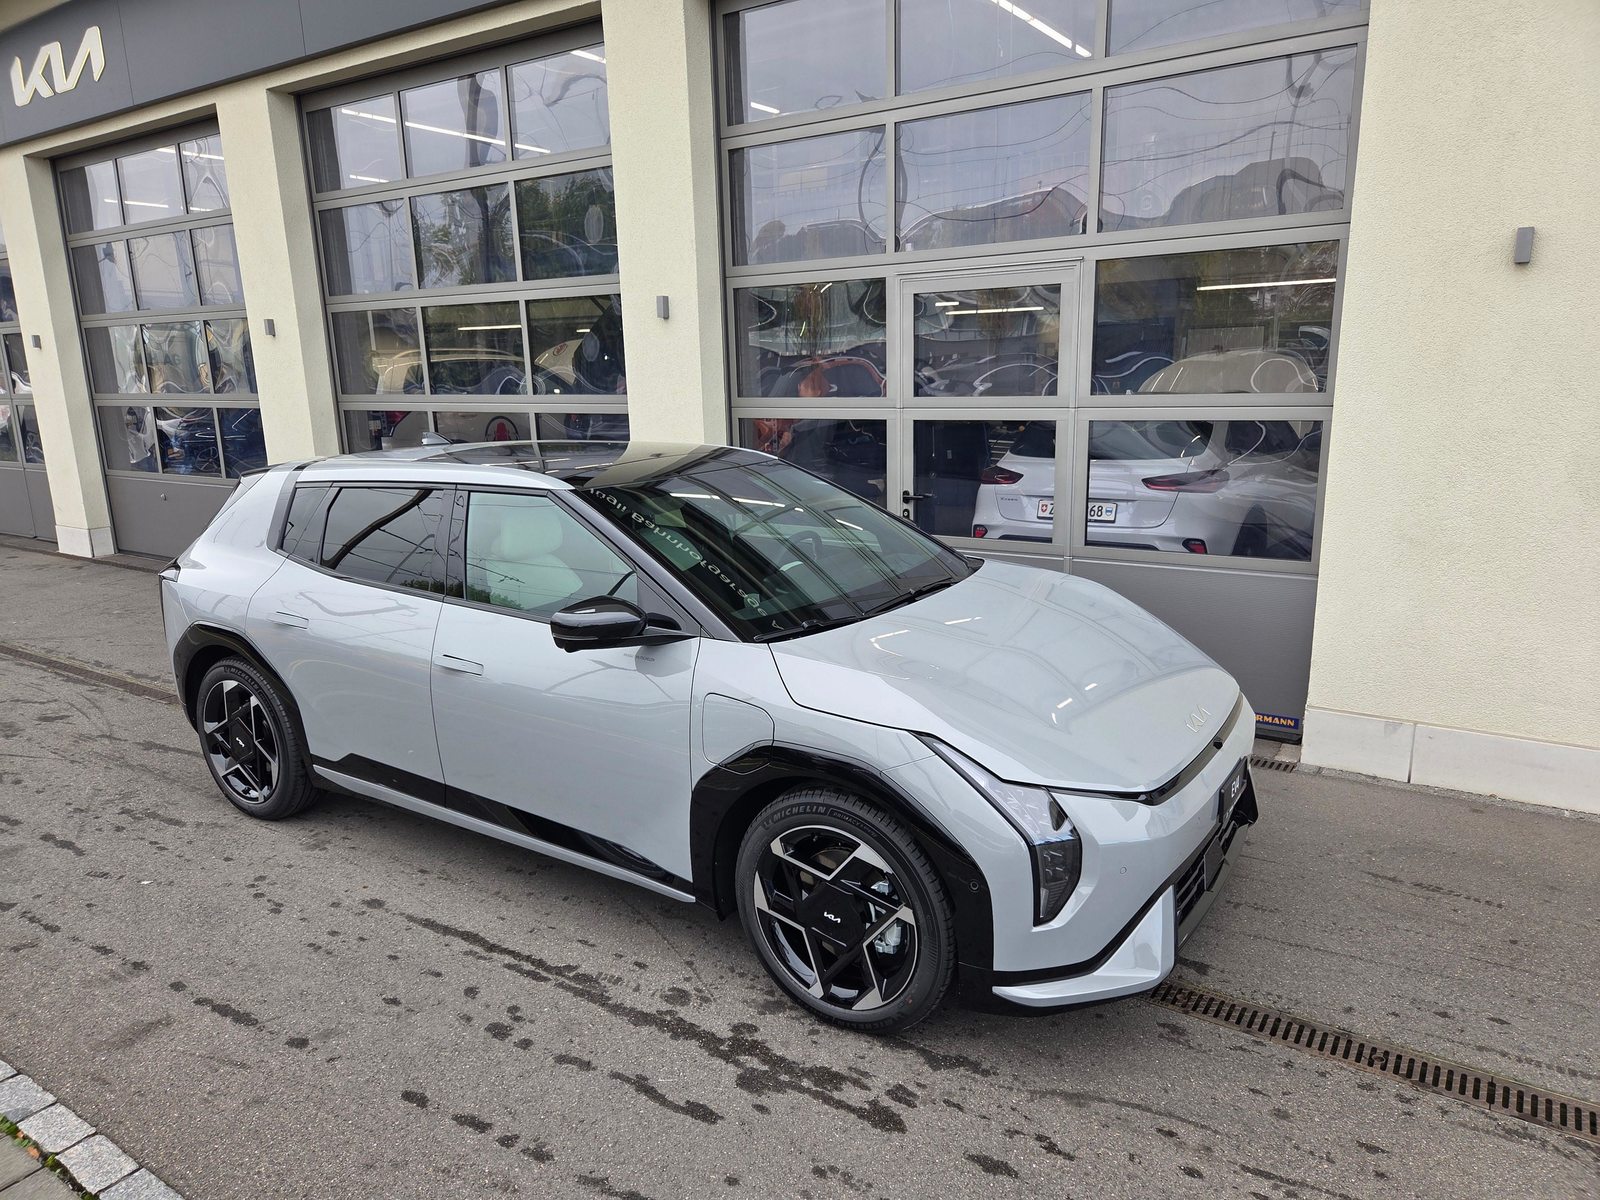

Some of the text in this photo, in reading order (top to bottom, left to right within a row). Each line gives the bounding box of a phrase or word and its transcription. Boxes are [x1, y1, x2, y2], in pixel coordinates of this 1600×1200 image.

[10, 25, 105, 107] KIA
[1089, 505, 1103, 518] 68
[1254, 714, 1295, 727] RMANN
[773, 805, 826, 824] MICHELIN
[823, 911, 841, 923] KIA
